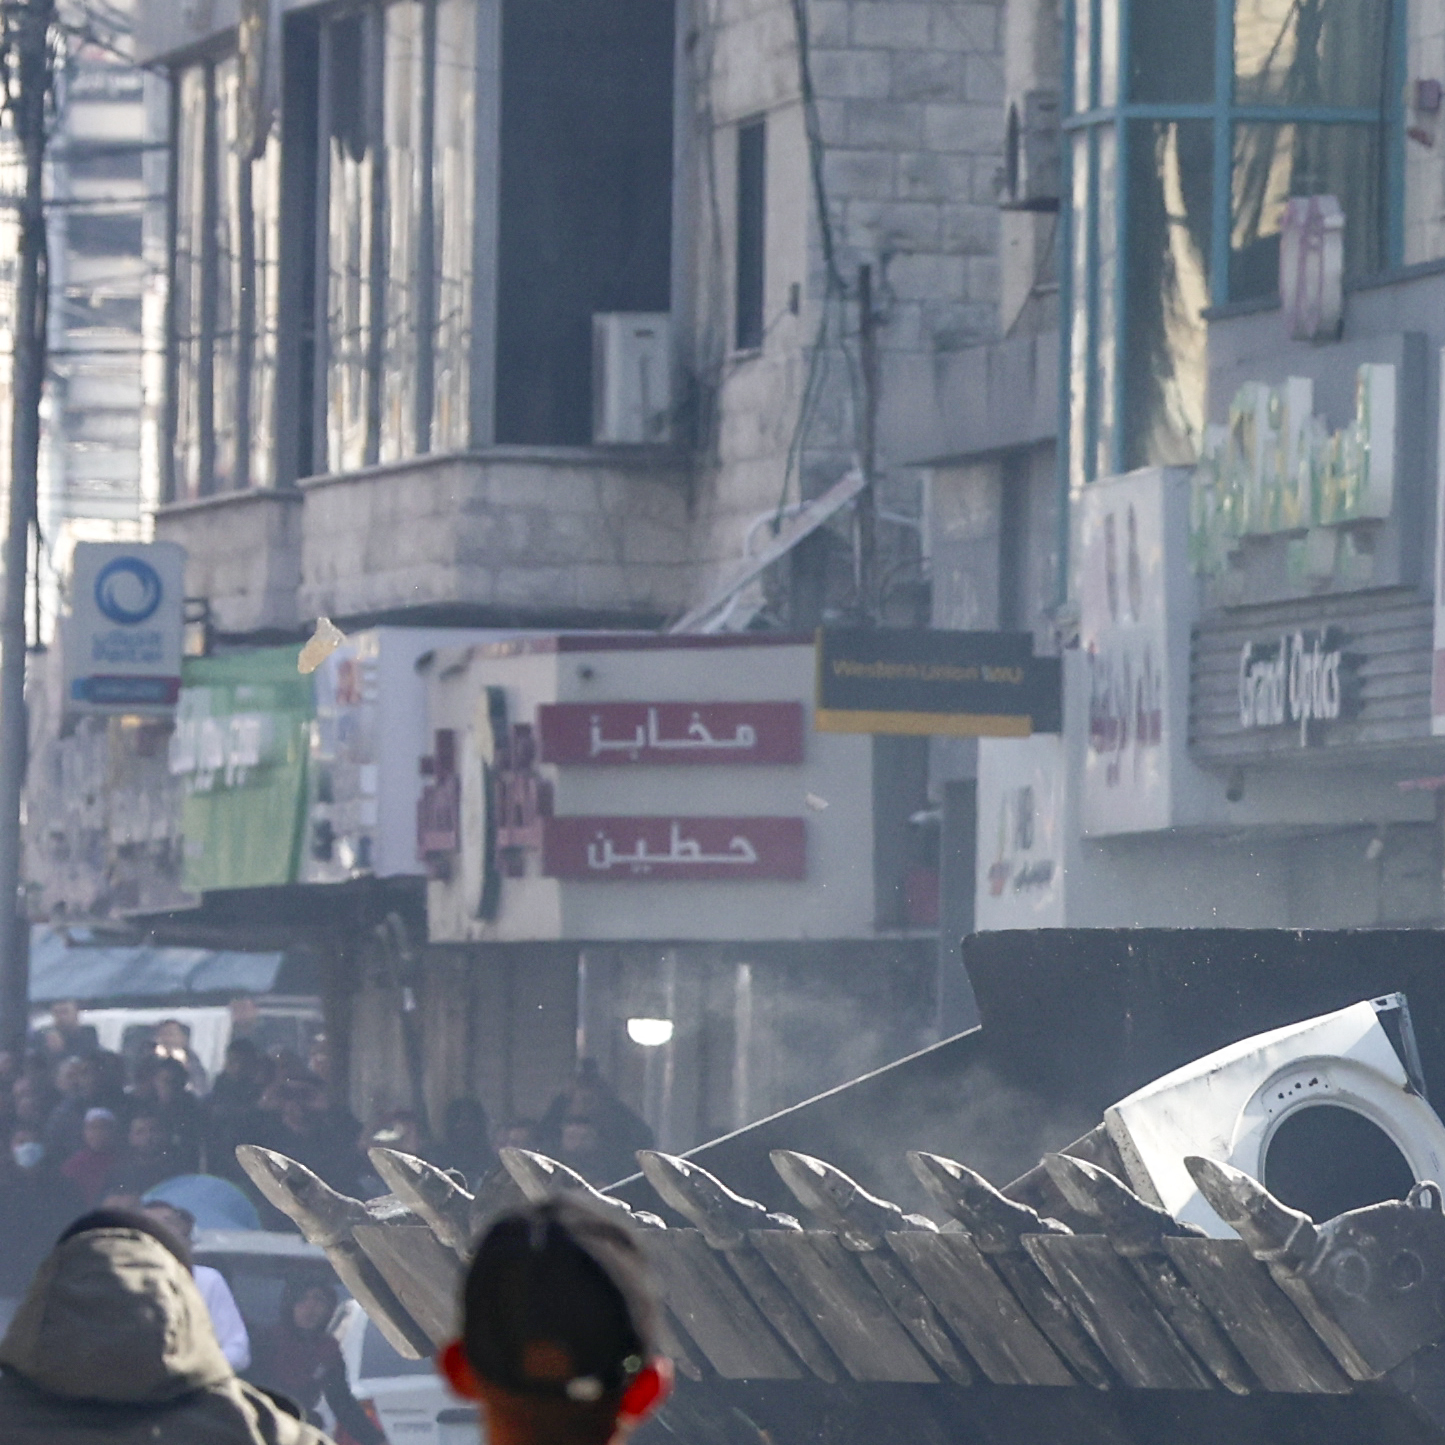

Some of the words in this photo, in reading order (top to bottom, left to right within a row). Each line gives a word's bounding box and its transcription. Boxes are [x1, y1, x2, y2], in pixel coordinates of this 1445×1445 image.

[1238, 634, 1287, 728] Grand
[1289, 624, 1341, 748] Optics
[591, 706, 758, 760] مخابز
[587, 821, 758, 874] حطين
